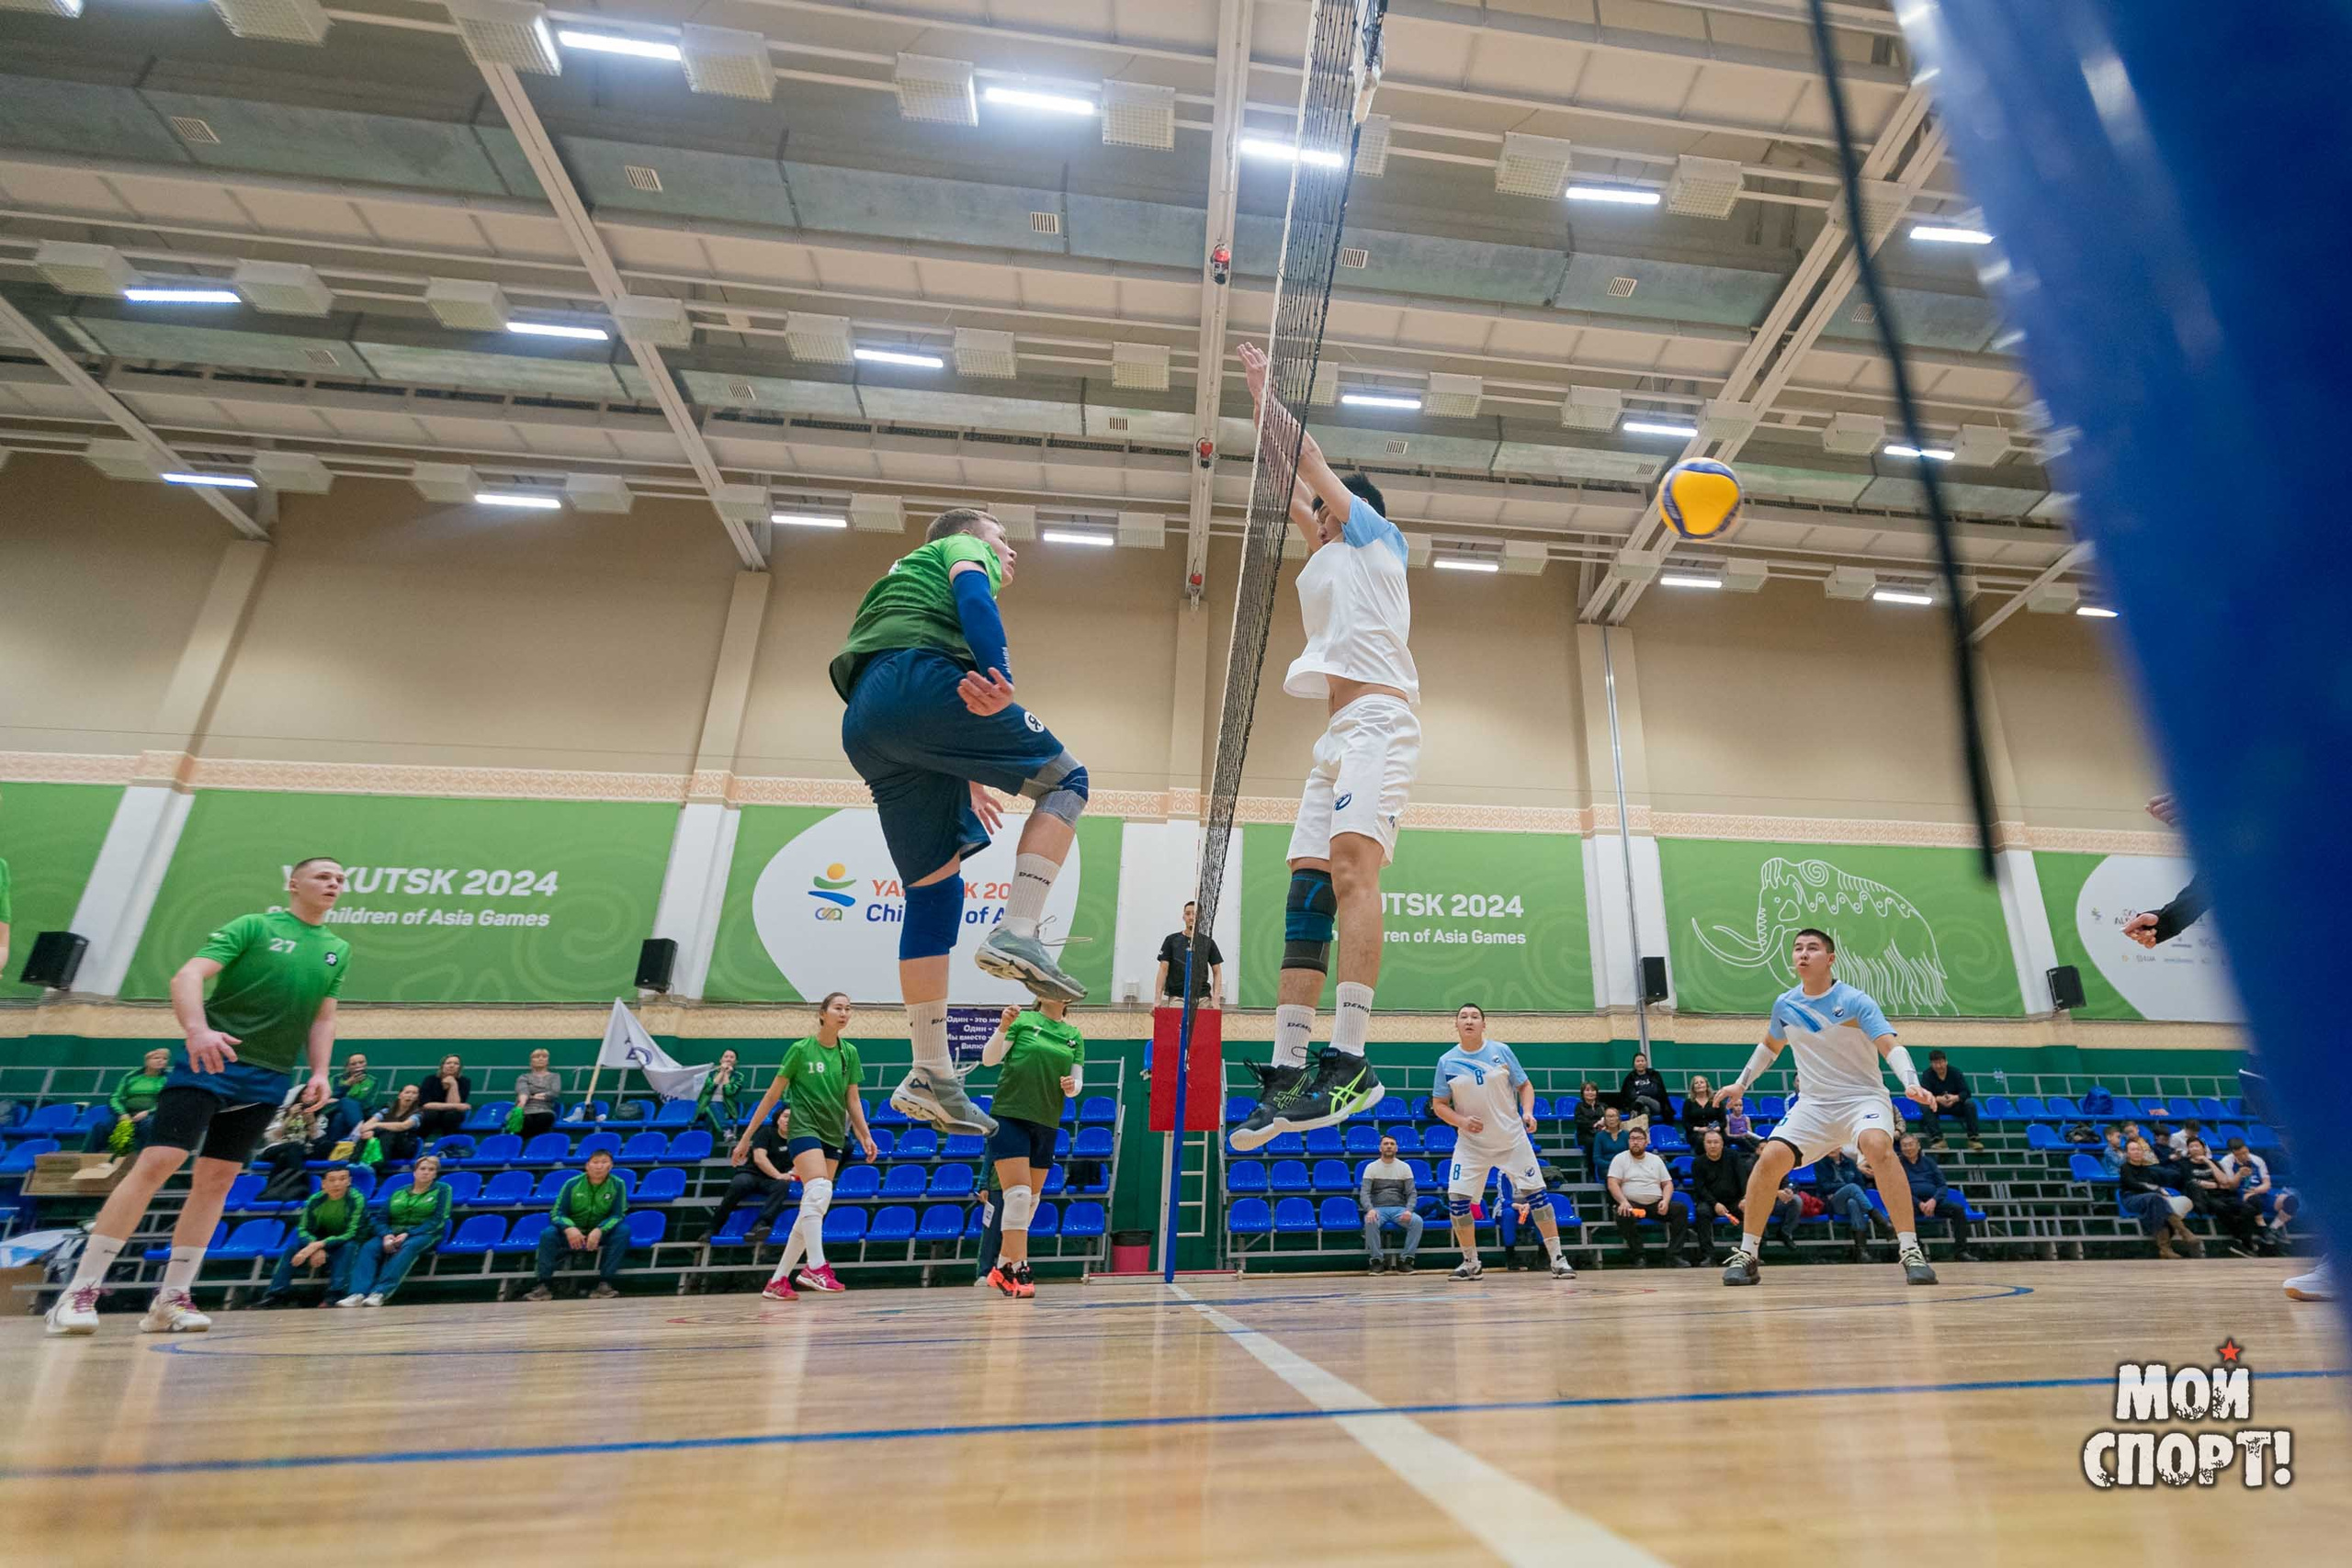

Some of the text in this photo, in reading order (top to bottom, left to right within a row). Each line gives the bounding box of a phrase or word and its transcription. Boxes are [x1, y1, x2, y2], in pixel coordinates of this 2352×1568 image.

[461, 869, 558, 897] 2024
[983, 883, 1012, 899] 20
[1451, 895, 1524, 918] 2024
[324, 907, 550, 927] hildren of Asia Games
[965, 906, 989, 924] of
[1413, 929, 1430, 943] of
[1433, 929, 1467, 943] Asia
[1472, 930, 1526, 944] Games
[269, 937, 297, 953] 27
[946, 1015, 968, 1024] Один
[963, 1024, 987, 1033] Один
[1033, 1026, 1043, 1037] 7
[808, 1061, 825, 1074] 18
[1476, 1070, 1484, 1086] 8
[1453, 1164, 1461, 1180] 8
